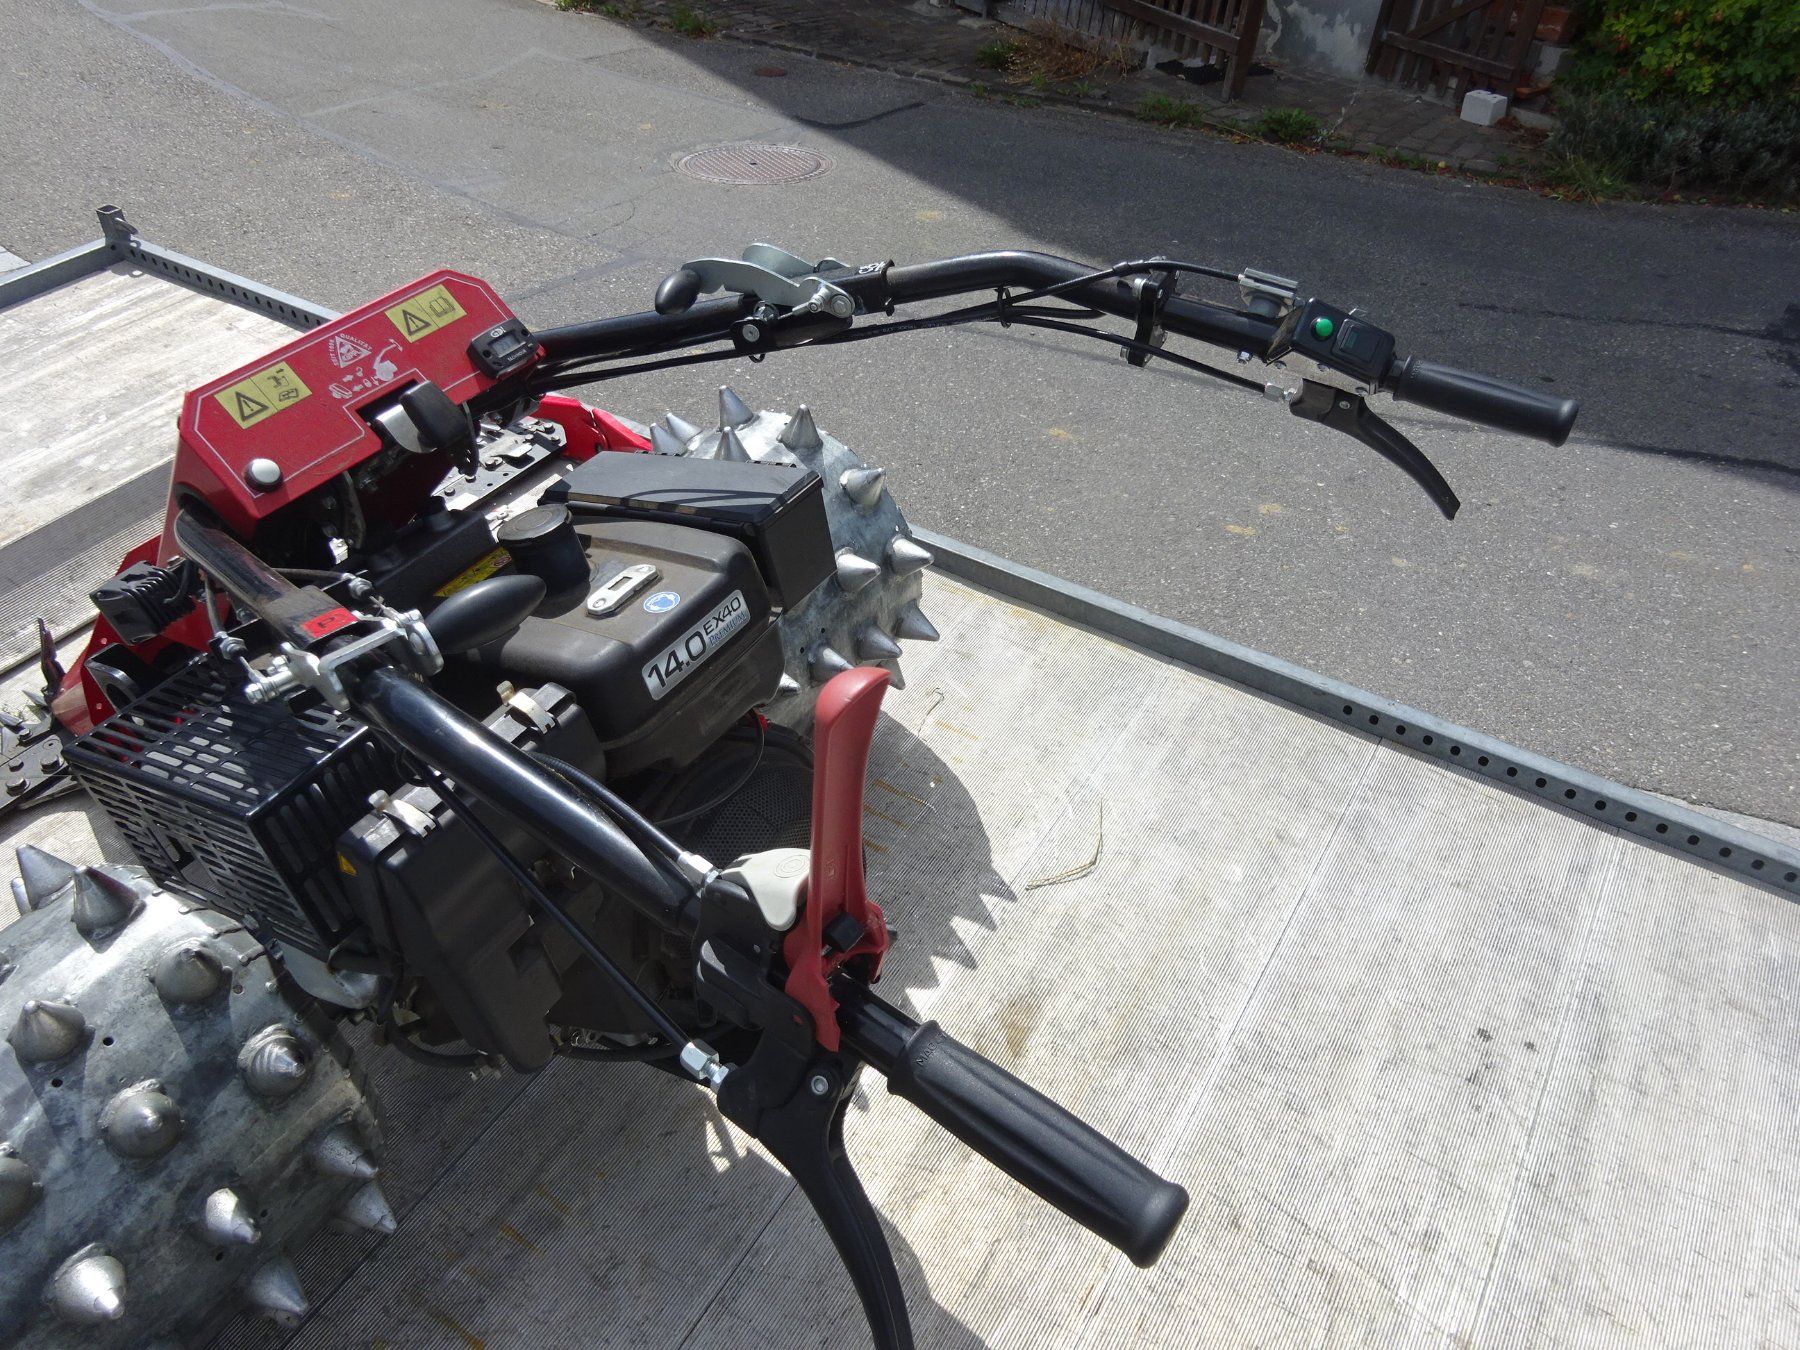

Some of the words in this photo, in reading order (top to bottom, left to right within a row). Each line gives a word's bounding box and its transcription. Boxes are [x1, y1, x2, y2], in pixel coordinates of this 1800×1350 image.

[647, 630, 707, 689] 14.0
[702, 596, 741, 635] EX40
[707, 611, 748, 647] PREMIUM
